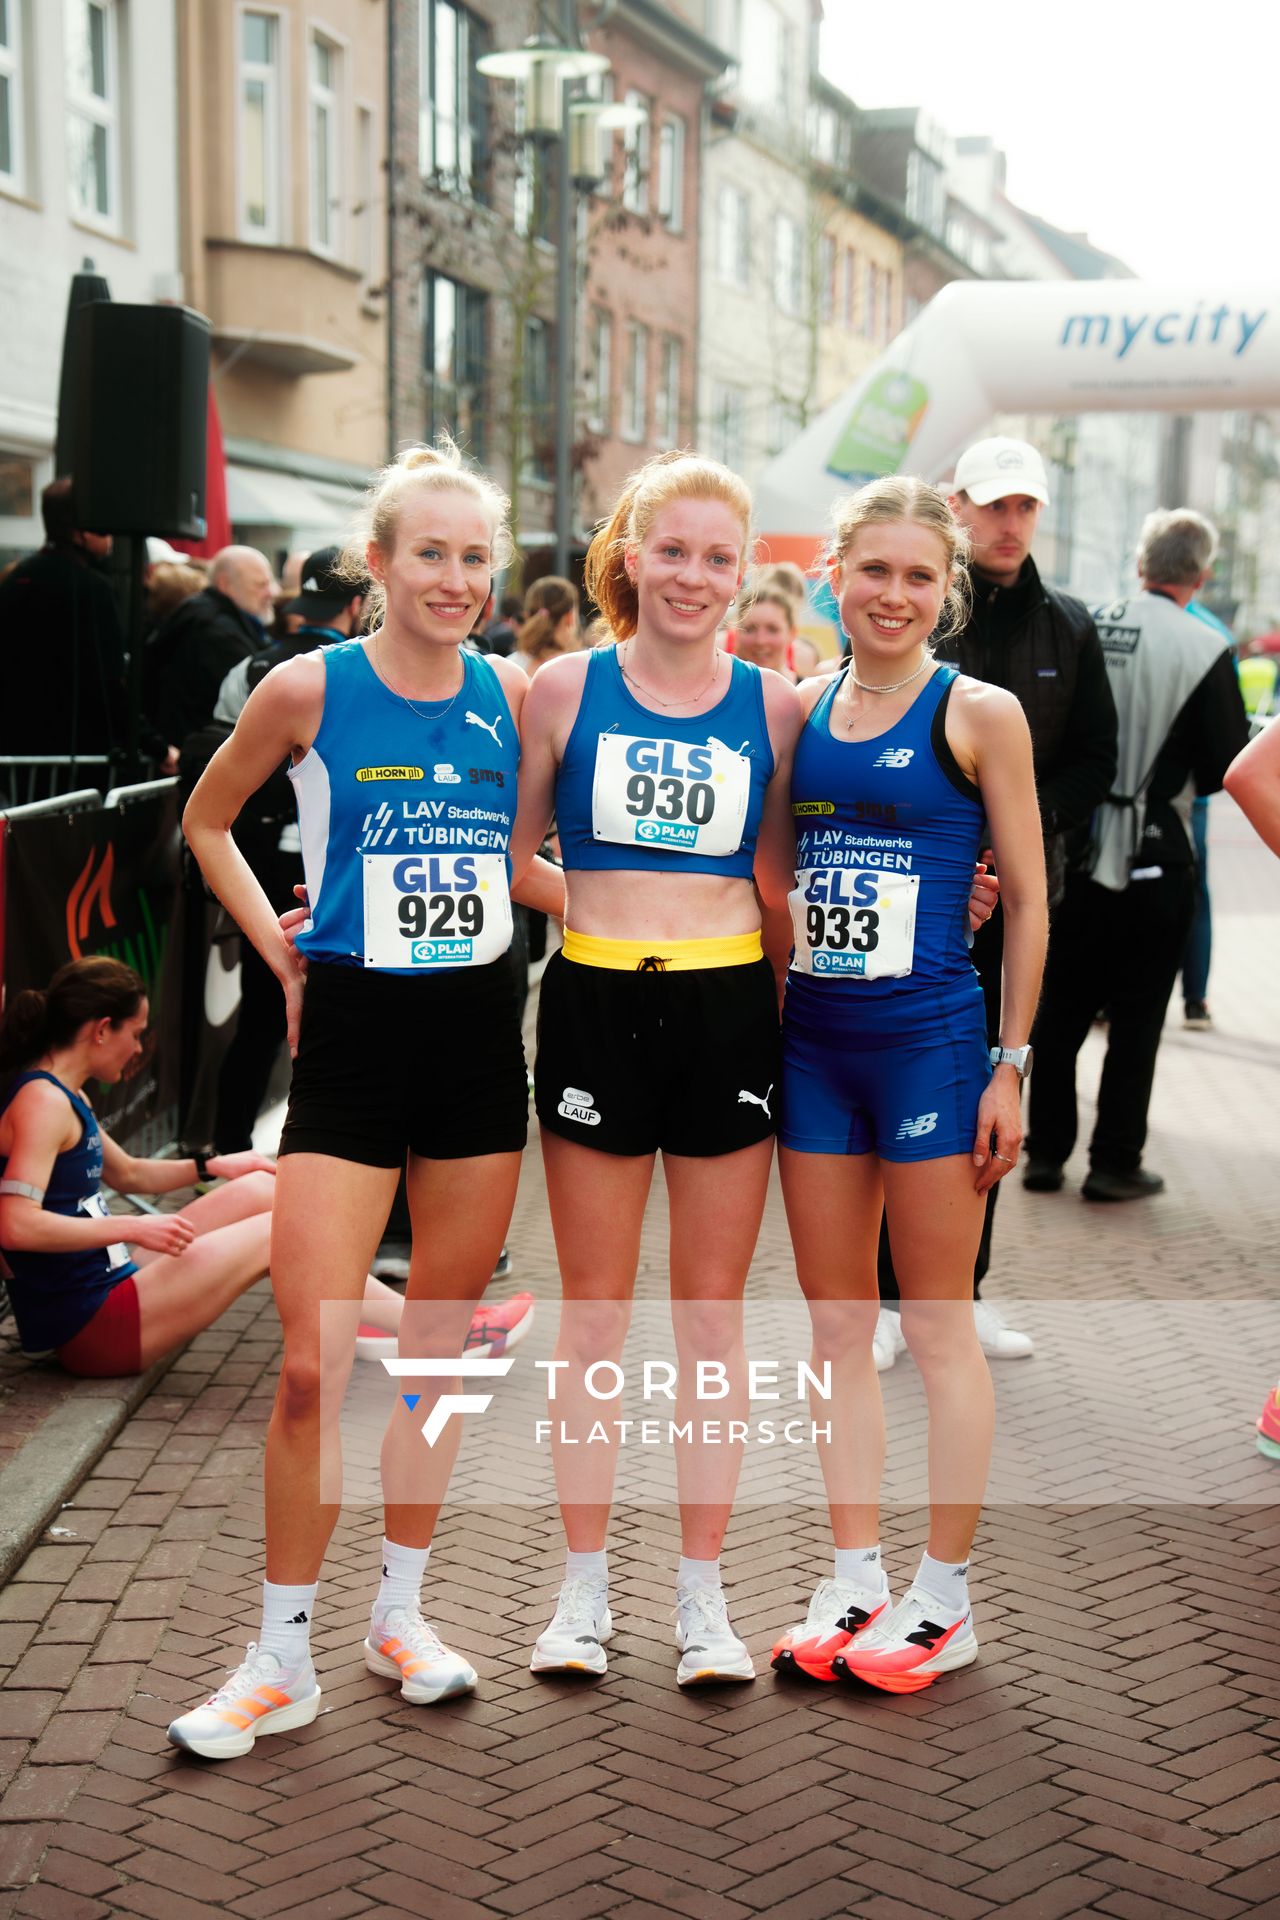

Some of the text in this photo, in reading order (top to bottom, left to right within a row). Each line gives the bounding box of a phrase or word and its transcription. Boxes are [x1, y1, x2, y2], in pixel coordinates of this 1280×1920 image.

[1058, 300, 1268, 360] mycity
[375, 768, 407, 778] HORN
[625, 774, 716, 826] 930
[402, 801, 510, 826] LAV Stadtwerke
[403, 822, 509, 851] TÜBINGEN
[661, 825, 696, 841] PLAN
[813, 830, 913, 849] LAV Stadtwerke
[811, 847, 913, 870] TÜBINGEN
[397, 893, 484, 939] 929
[806, 904, 880, 953] 933
[437, 942, 471, 955] PLAN
[831, 955, 864, 968] PLAN
[563, 1104, 597, 1122] LAUF
